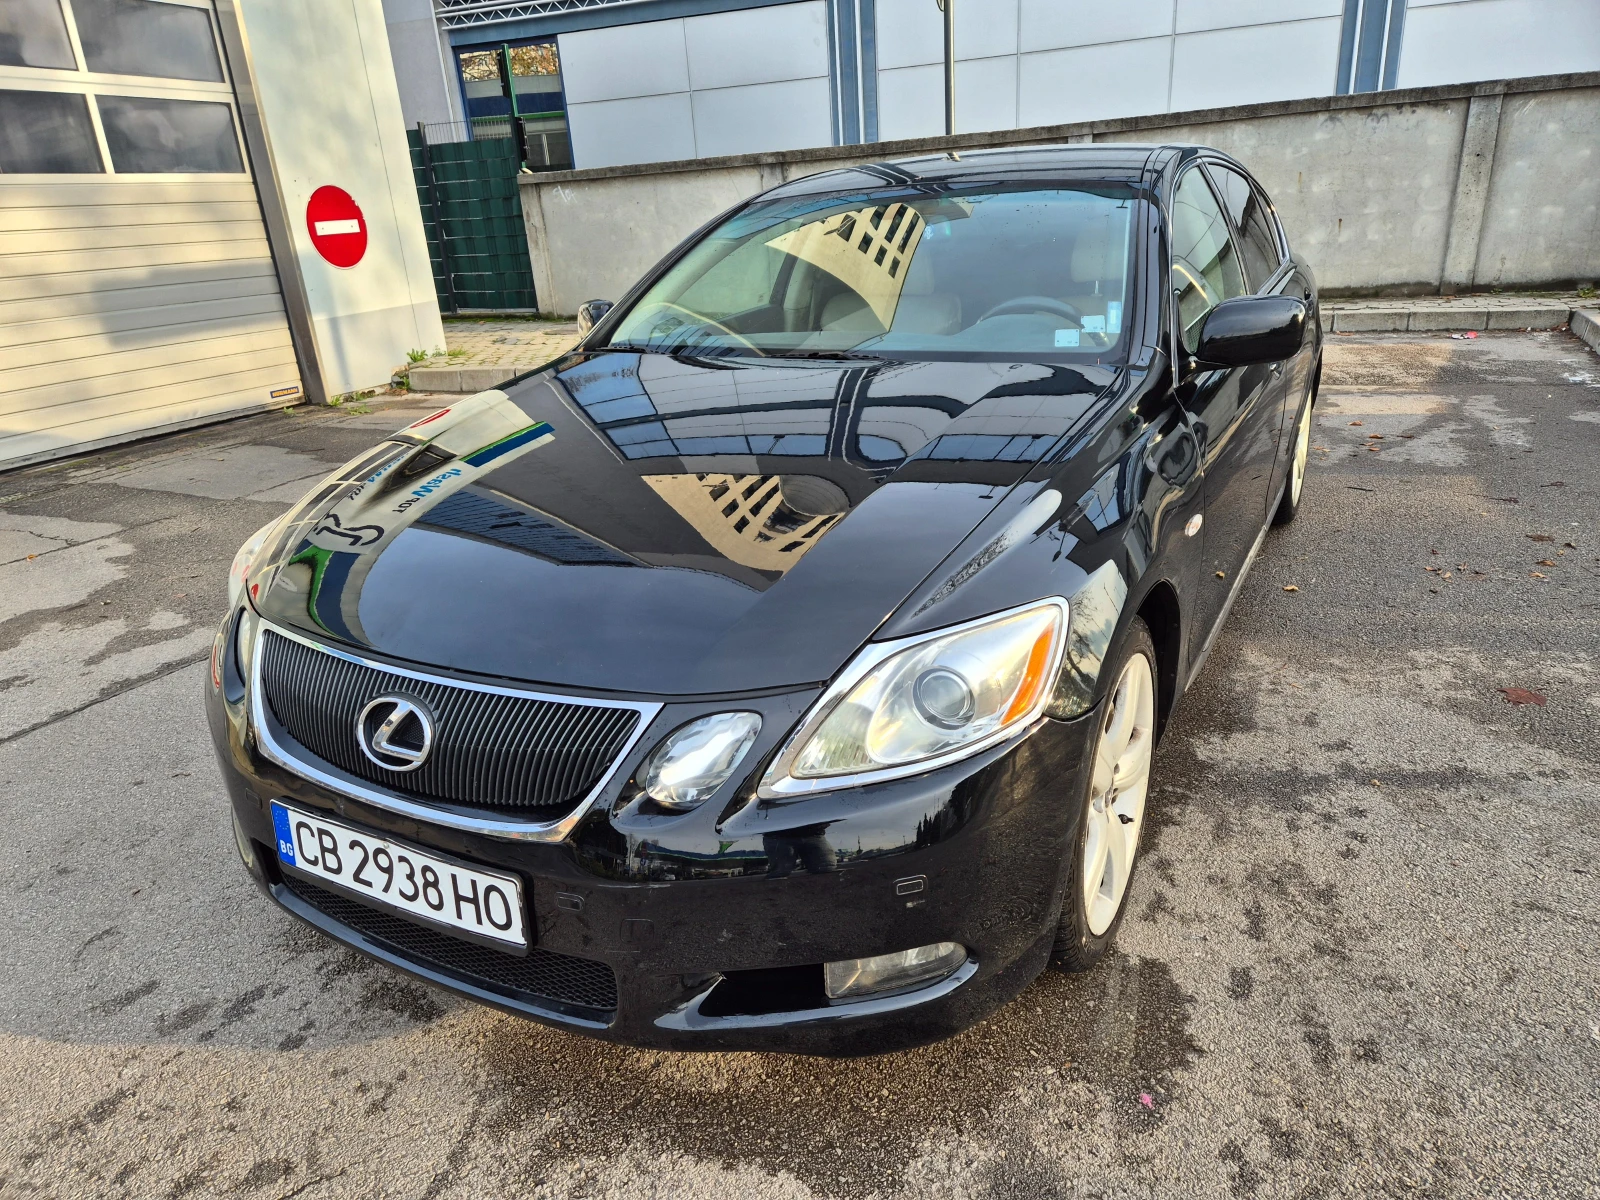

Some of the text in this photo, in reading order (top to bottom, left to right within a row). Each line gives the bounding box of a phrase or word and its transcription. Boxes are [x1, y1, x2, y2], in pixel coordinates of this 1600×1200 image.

[280, 839, 294, 857] BG
[295, 821, 513, 931] CB 2938 HO
